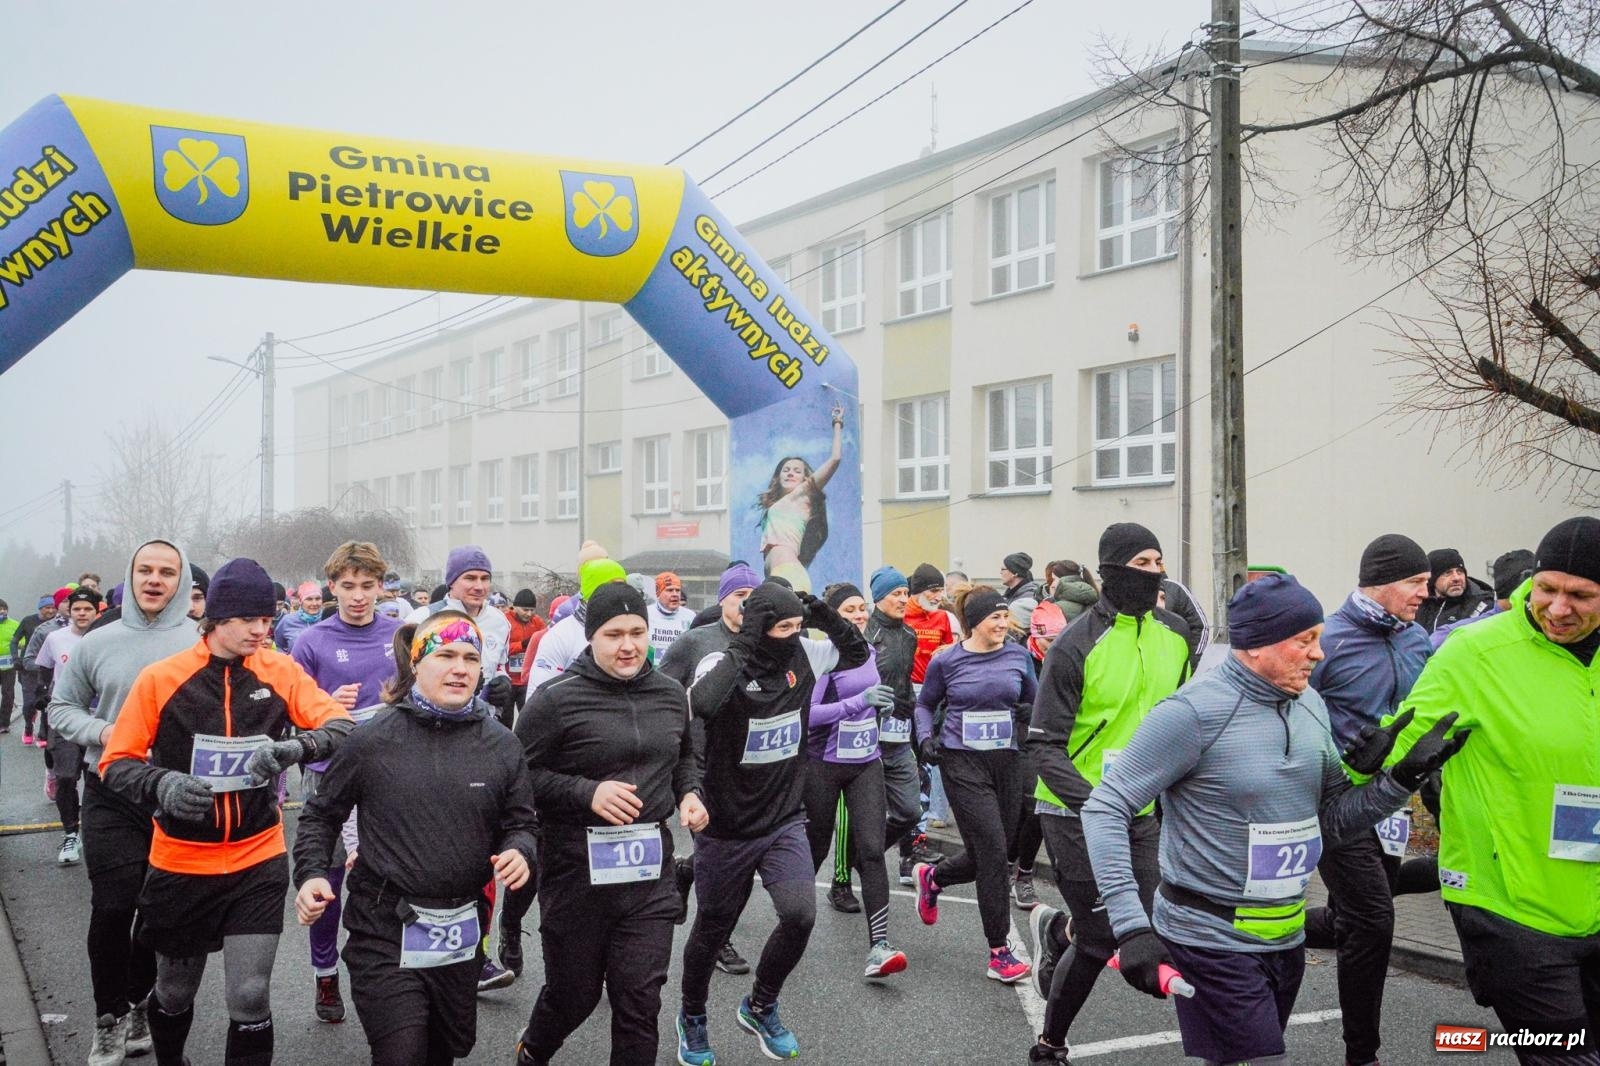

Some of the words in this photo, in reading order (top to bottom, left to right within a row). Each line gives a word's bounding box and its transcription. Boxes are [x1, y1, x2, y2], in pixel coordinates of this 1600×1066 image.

[328, 145, 492, 183] Gmina
[287, 170, 534, 222] Pietrowice
[320, 212, 501, 255] Wielkie
[694, 214, 769, 302] Gmina
[766, 294, 830, 366] ludzi
[670, 246, 804, 389] aktywnych
[758, 725, 792, 751] 141
[853, 730, 871, 748] 63
[979, 723, 1000, 740] 11
[613, 840, 645, 866] 10
[1275, 843, 1307, 878] 22
[428, 924, 463, 950] 98
